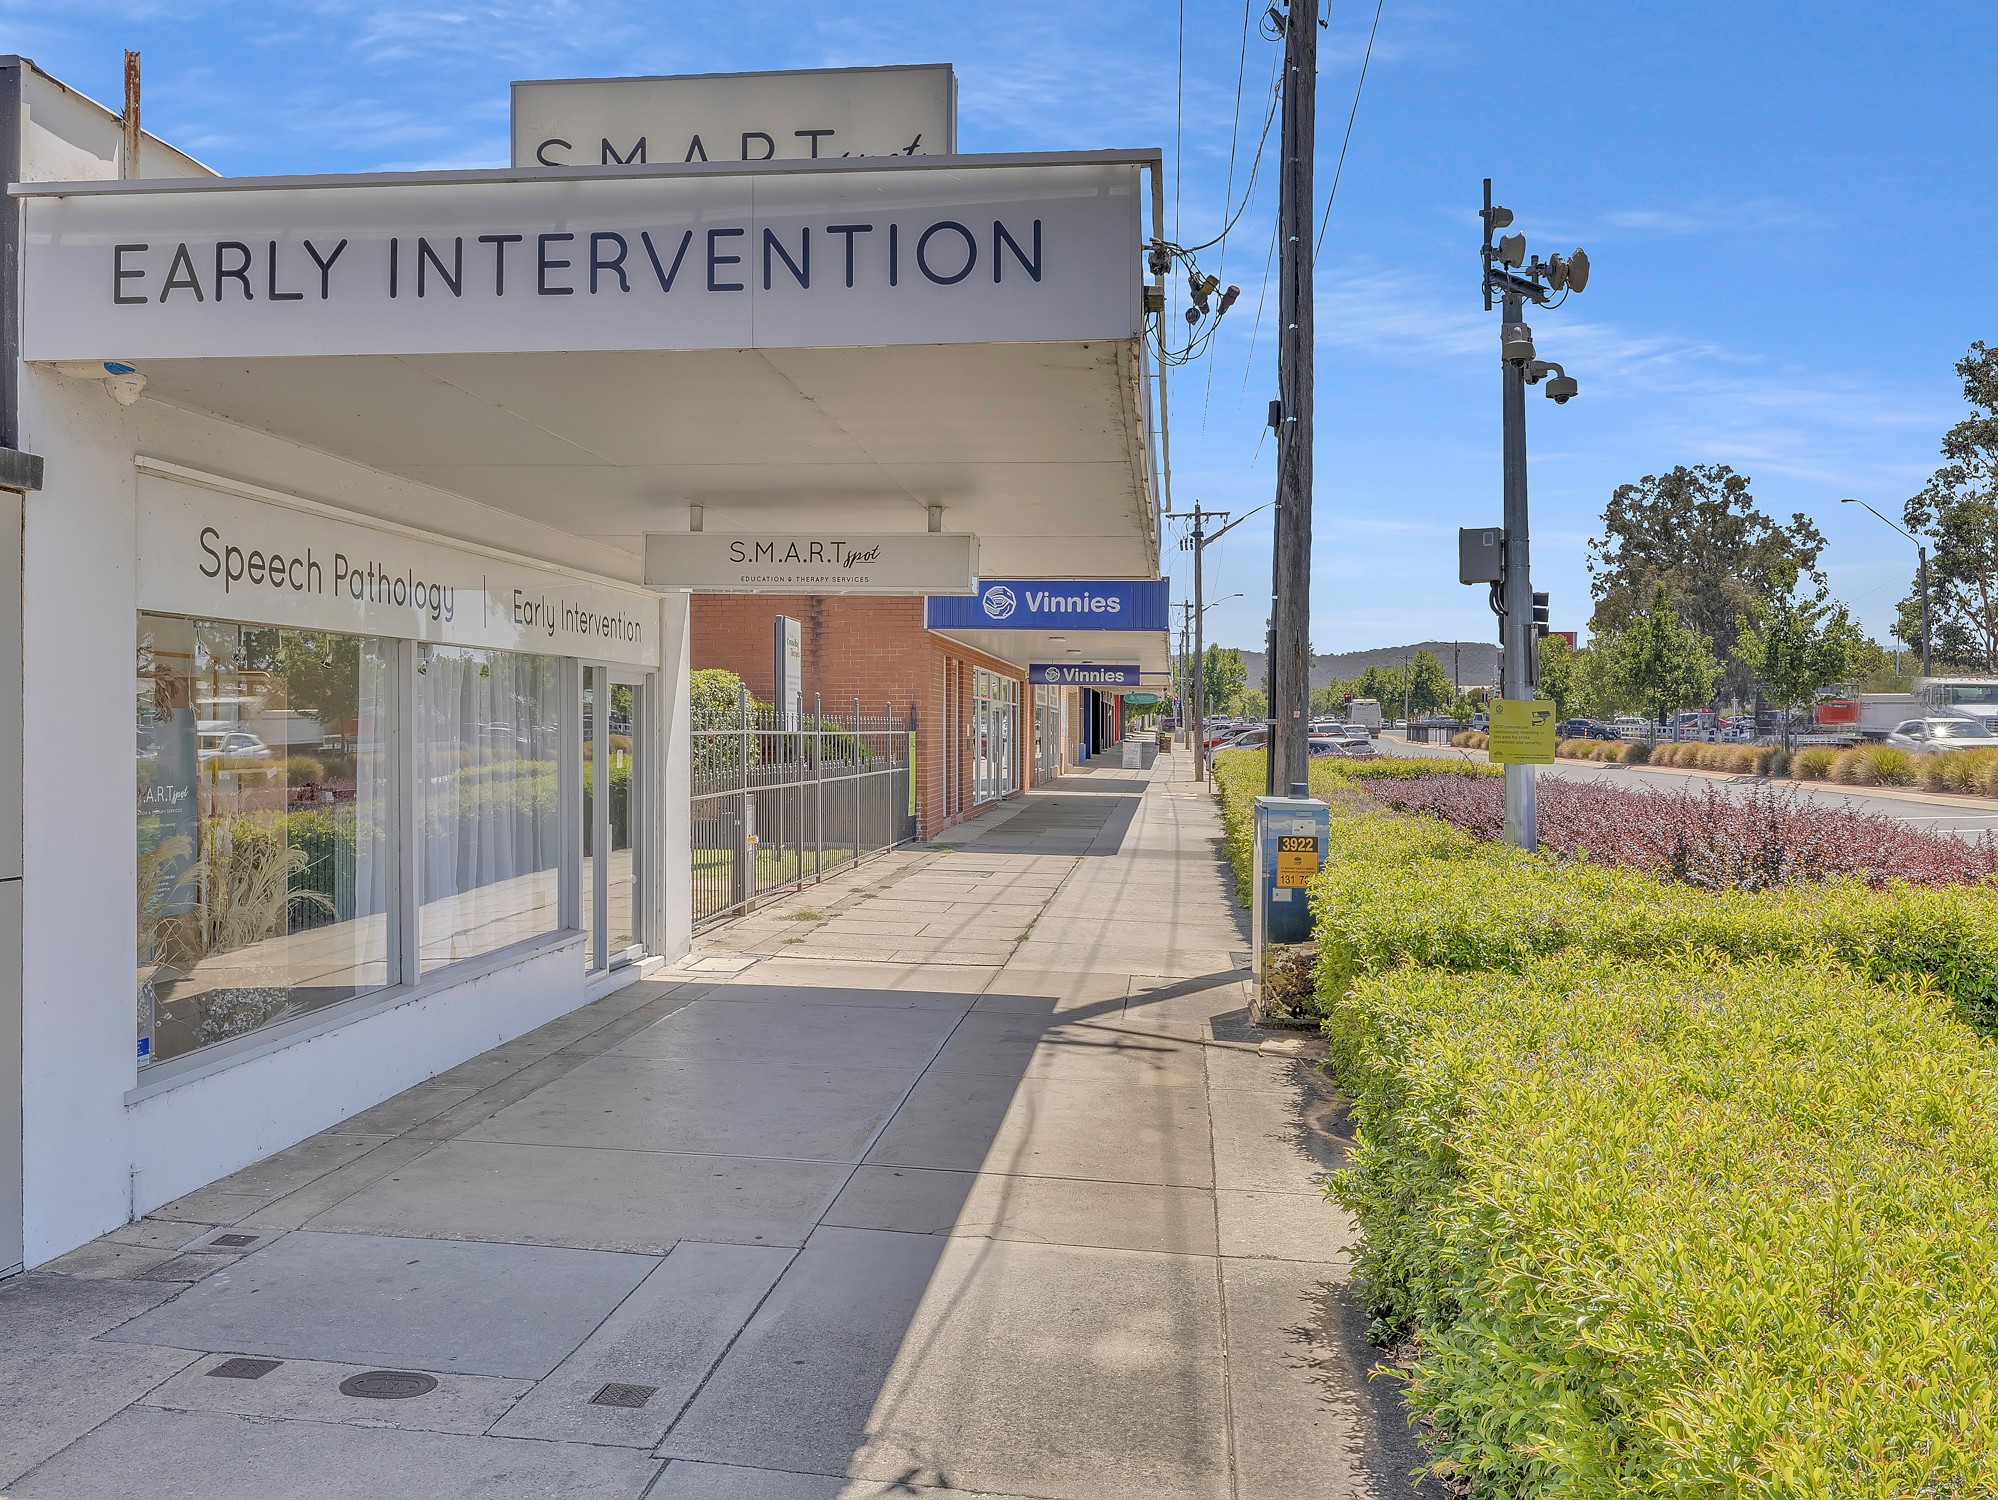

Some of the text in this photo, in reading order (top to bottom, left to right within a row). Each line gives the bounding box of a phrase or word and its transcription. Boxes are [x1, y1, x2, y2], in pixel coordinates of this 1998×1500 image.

[112, 219, 1043, 305] EARLY INTERVENTION
[843, 544, 881, 568] spot
[198, 526, 642, 643] Speech Pathology Early Intervention
[1025, 591, 1121, 613] Vinnies
[1064, 668, 1124, 682] Vinnies
[1282, 838, 1313, 851] 3922
[1280, 875, 1295, 884] 131
